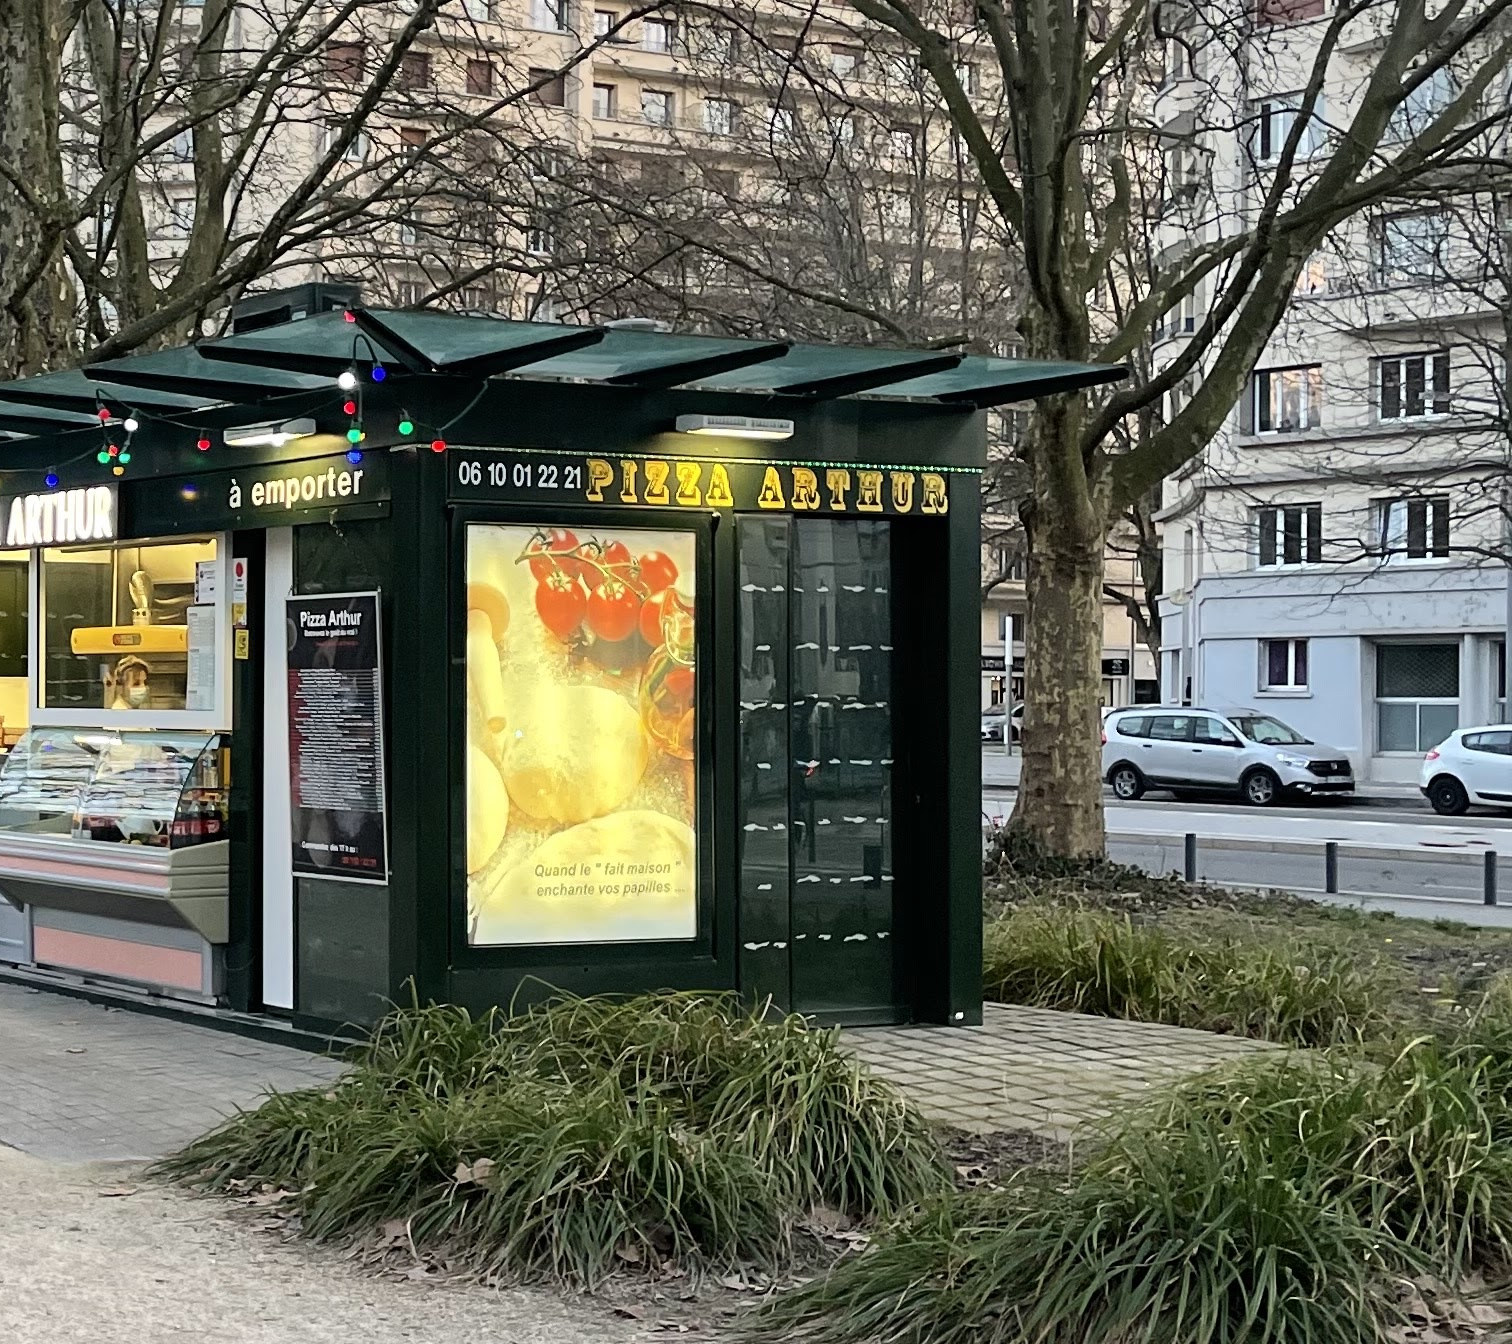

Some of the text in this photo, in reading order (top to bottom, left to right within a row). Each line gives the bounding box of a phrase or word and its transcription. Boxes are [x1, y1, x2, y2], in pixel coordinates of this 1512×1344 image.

[229, 466, 363, 509] à emporter
[458, 461, 581, 489] 06 10 01 22 21
[586, 458, 949, 514] PIZZA ARTHUR
[6, 486, 114, 547] ARTHUR
[300, 609, 362, 628] Pizza Arthur
[534, 862, 577, 877] Quand
[579, 862, 592, 876] le
[604, 862, 624, 876] fait
[626, 862, 671, 875] maison
[536, 882, 595, 897] enchante
[598, 883, 620, 895] vos
[622, 880, 671, 897] papilles
